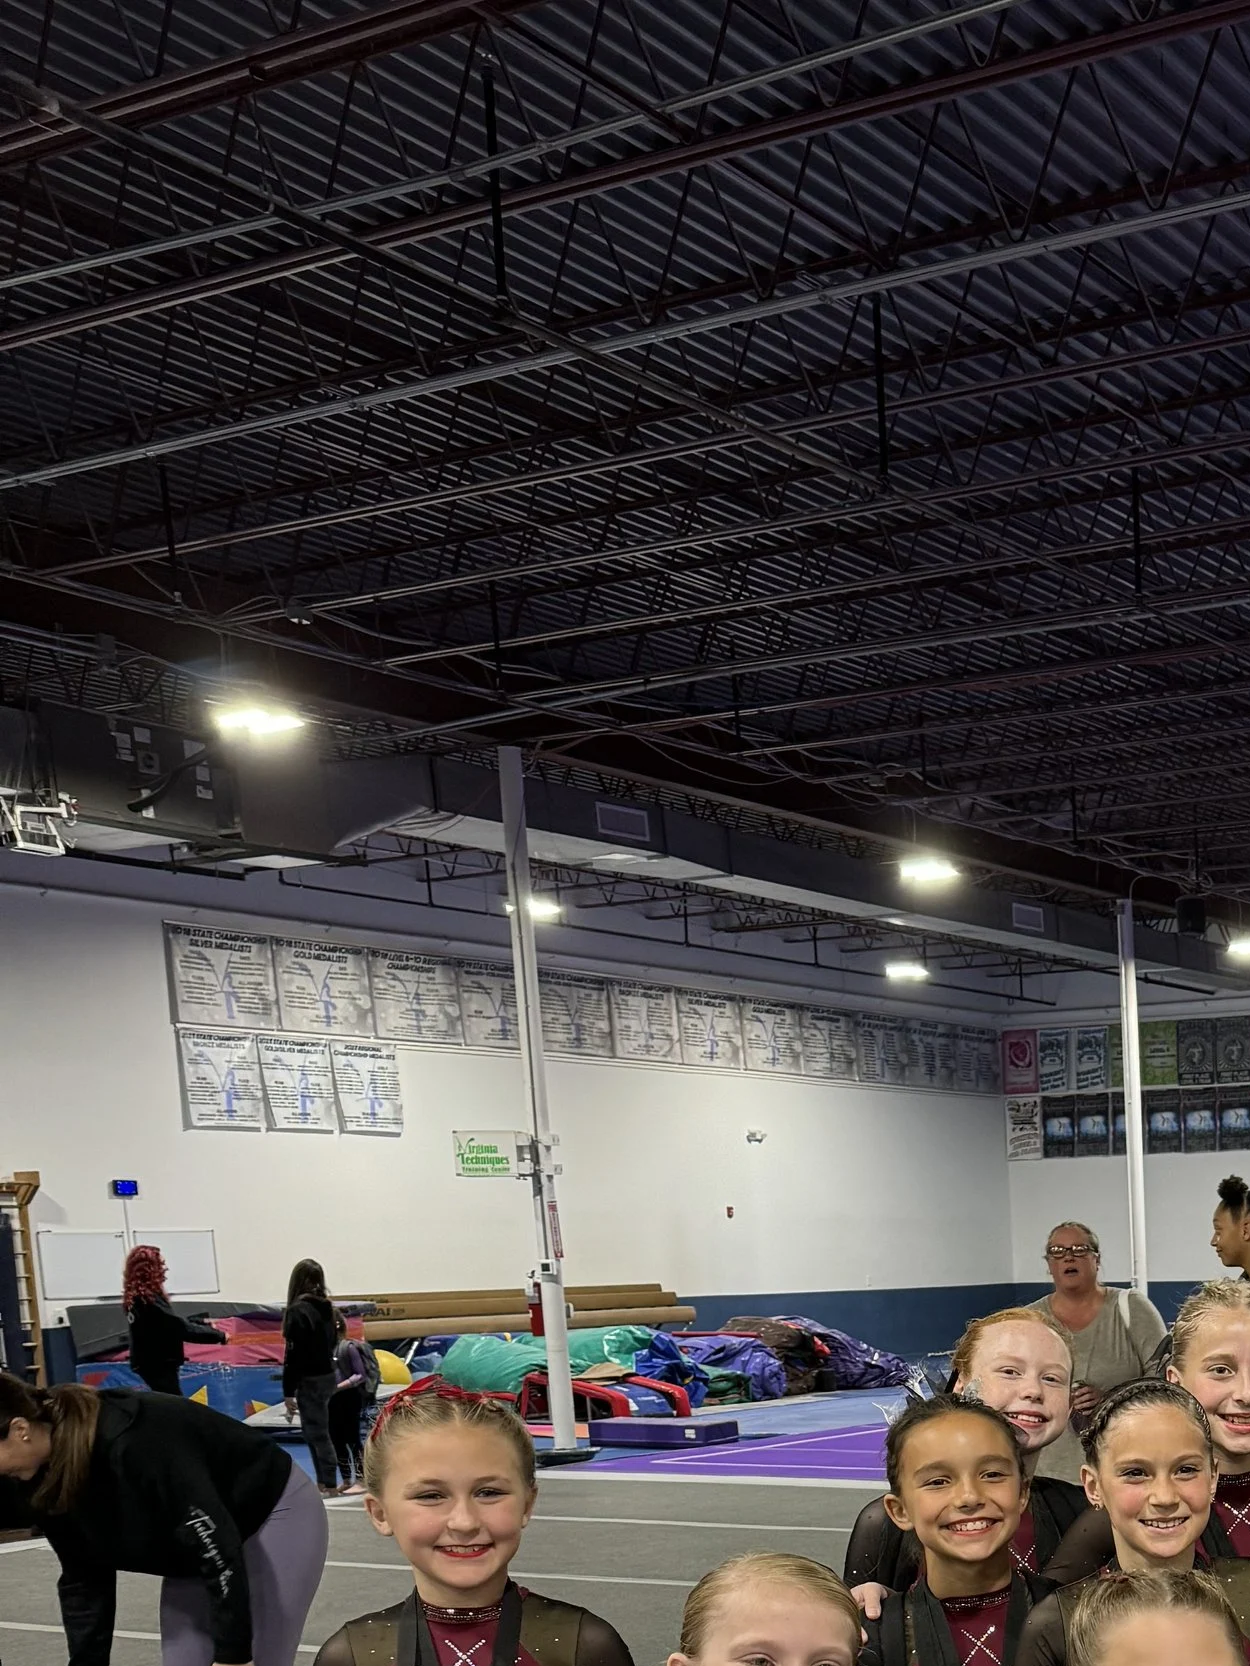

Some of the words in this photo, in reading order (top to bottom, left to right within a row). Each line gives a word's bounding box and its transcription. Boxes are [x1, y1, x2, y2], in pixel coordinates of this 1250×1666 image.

[193, 929, 213, 939] STATE
[215, 932, 267, 944] CHAMPIONSHIP
[189, 938, 212, 948] SILVER
[214, 942, 251, 953] MEDALISTS
[293, 941, 312, 950] STATE
[314, 944, 361, 955] CHAMPIONSHIP
[294, 950, 312, 959] GOLD
[313, 952, 347, 963] MEDALISTS
[455, 1135, 498, 1154] Virginia
[457, 1153, 510, 1166] Techniques
